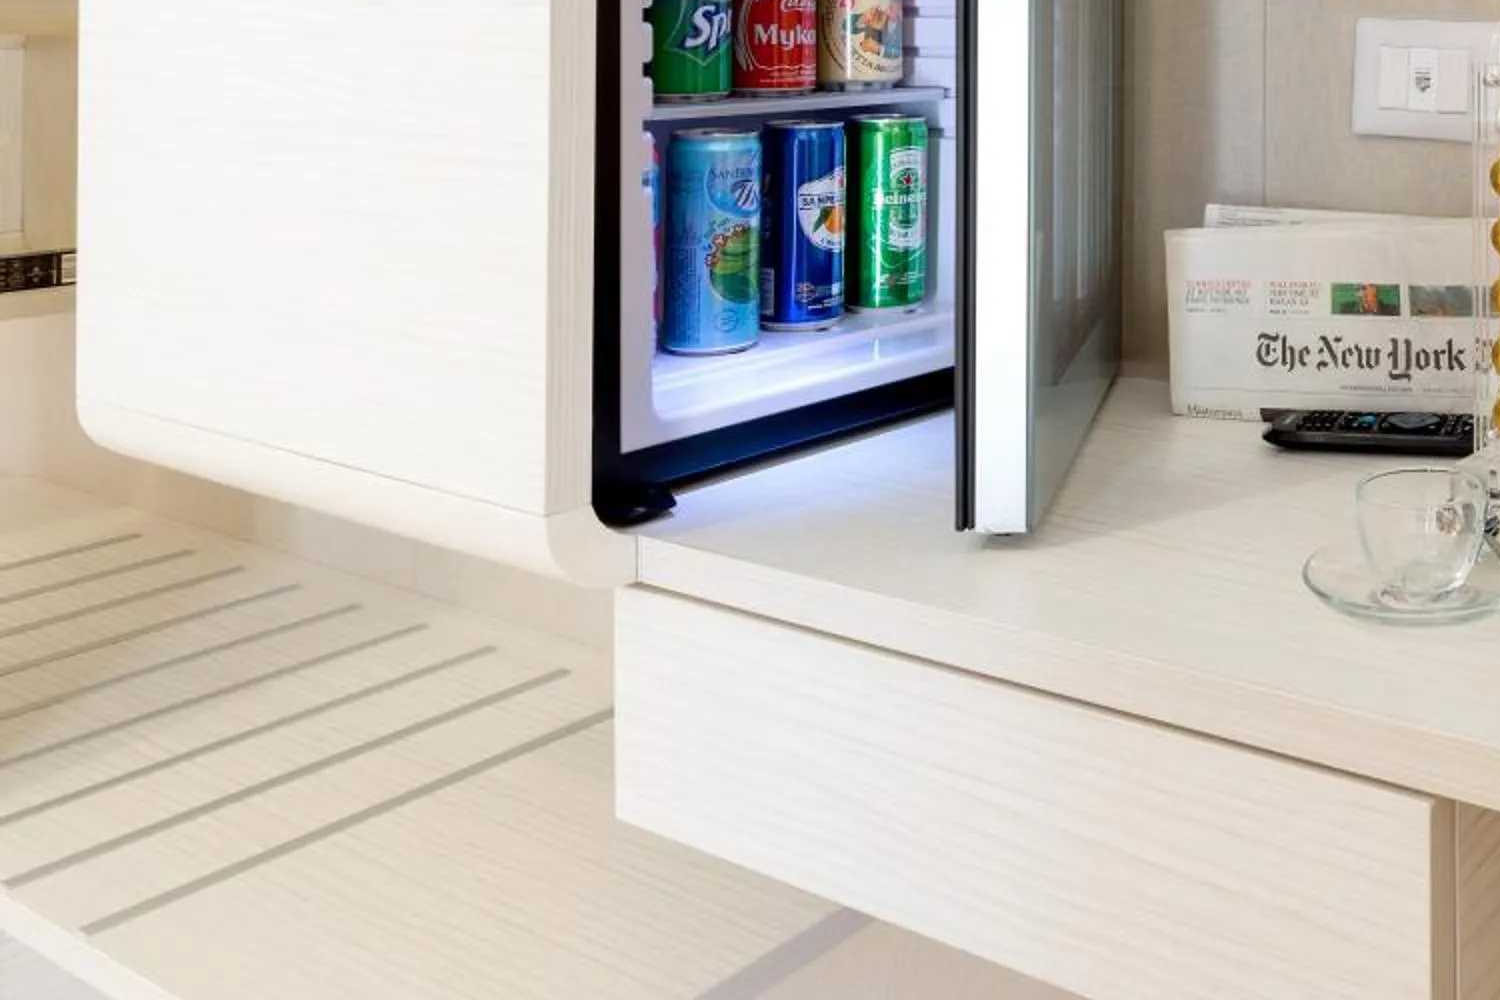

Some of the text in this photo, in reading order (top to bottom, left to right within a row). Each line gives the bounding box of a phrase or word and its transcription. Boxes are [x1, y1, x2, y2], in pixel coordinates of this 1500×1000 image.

[1256, 332, 1310, 372] The
[1316, 335, 1381, 370] New
[1387, 337, 1466, 381] York
